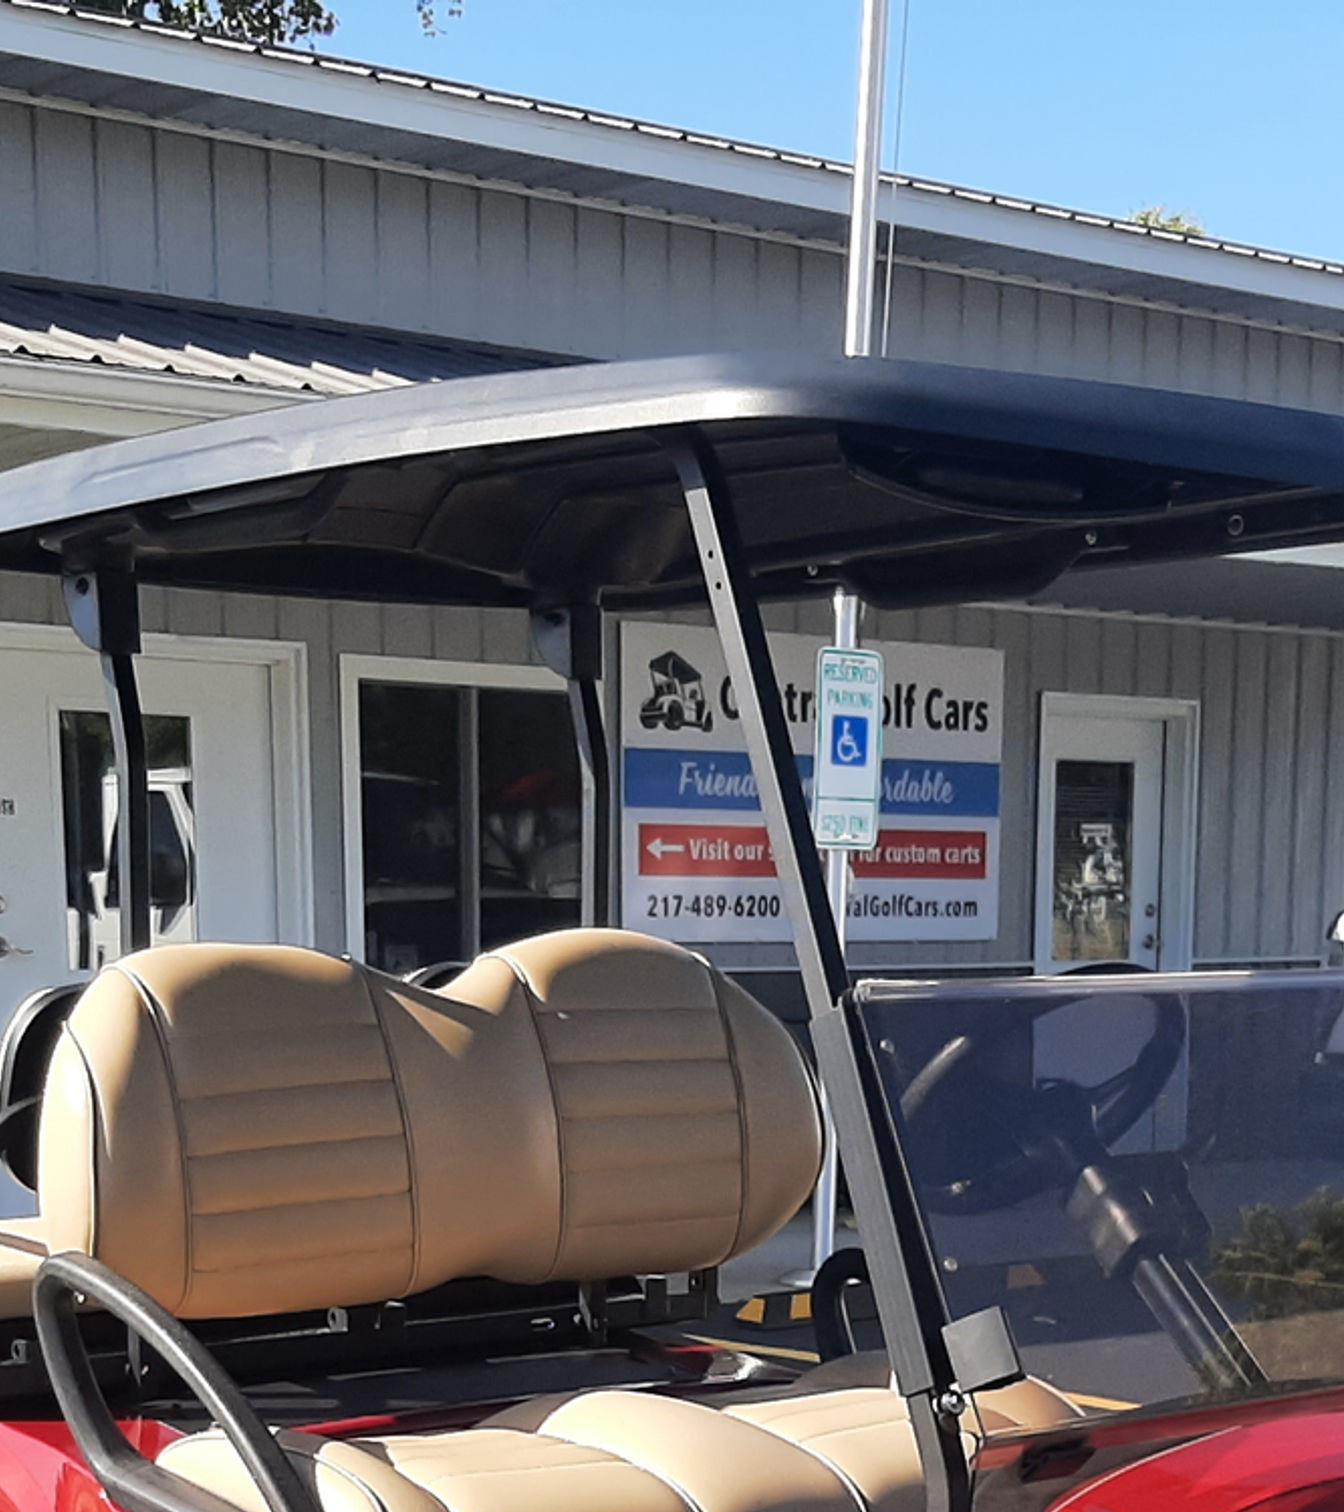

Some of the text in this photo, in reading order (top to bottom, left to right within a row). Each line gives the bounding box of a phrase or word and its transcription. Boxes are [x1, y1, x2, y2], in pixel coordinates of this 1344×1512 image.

[823, 663, 878, 684] RESERVED
[882, 683, 989, 732] olf Cars
[679, 761, 760, 797] Friend
[689, 838, 730, 861] Visit
[734, 844, 765, 861] our
[885, 845, 941, 864] custom
[944, 845, 981, 865] carts
[647, 894, 781, 918] 217-489-6200
